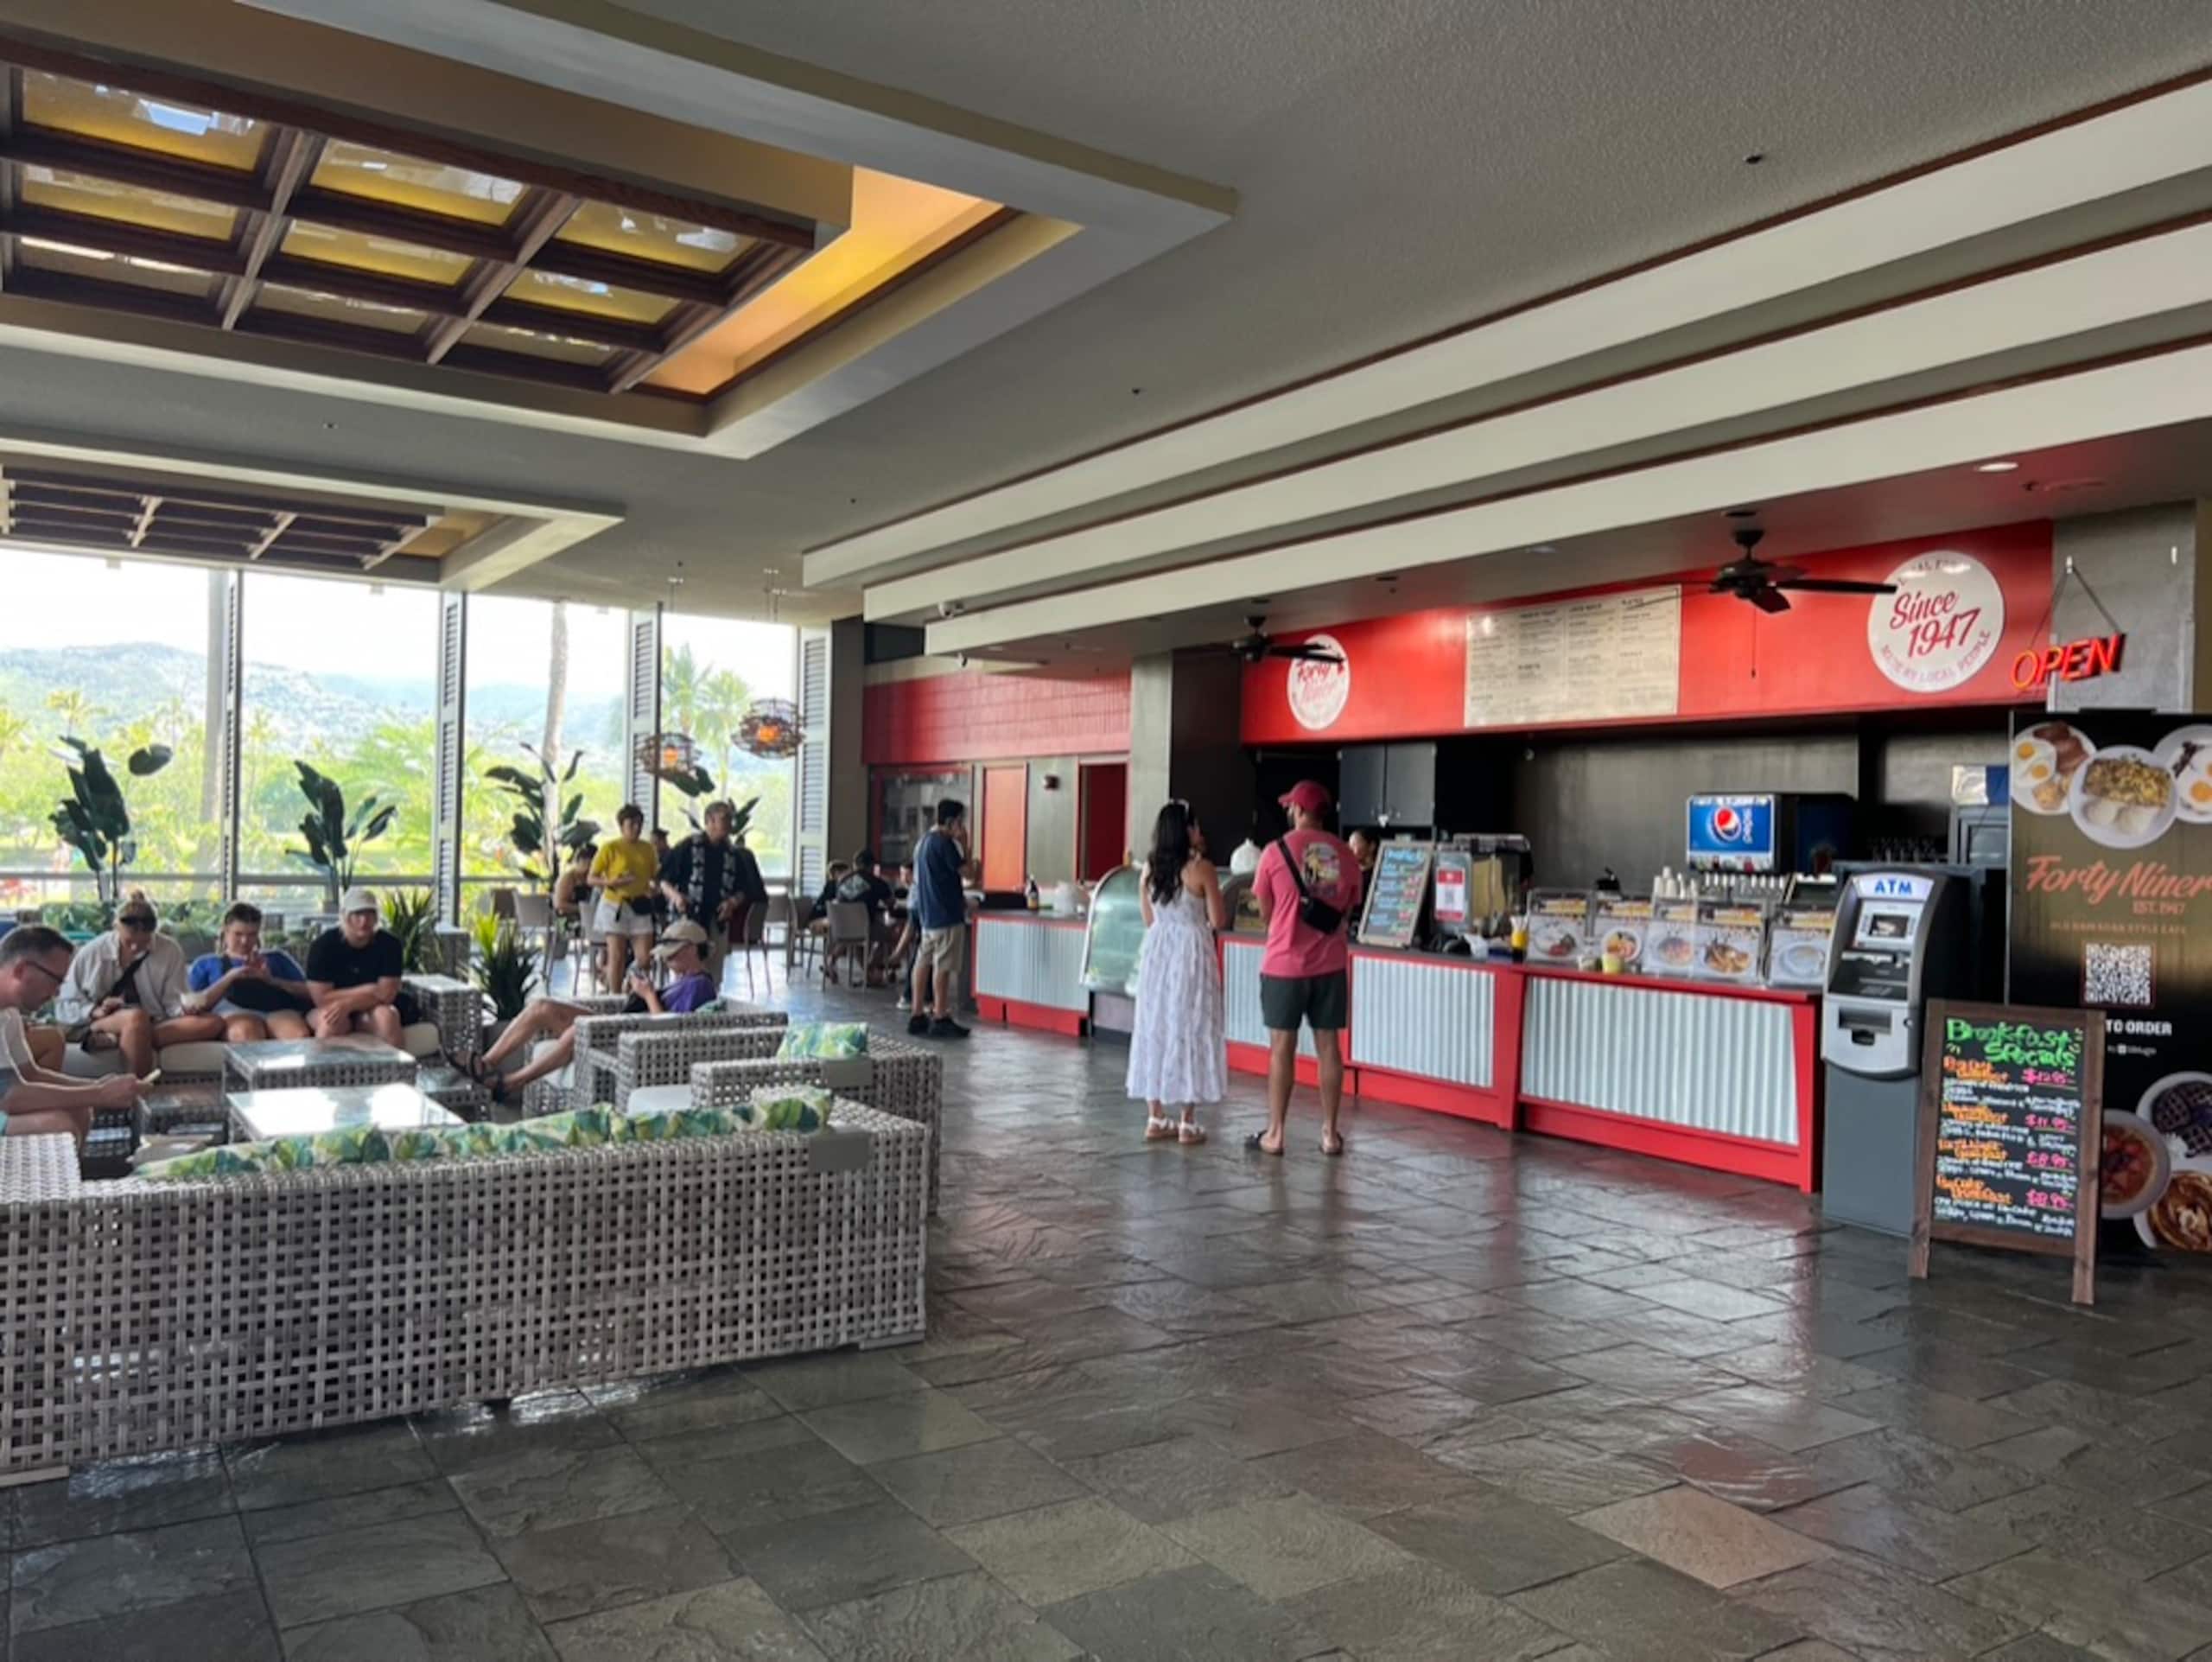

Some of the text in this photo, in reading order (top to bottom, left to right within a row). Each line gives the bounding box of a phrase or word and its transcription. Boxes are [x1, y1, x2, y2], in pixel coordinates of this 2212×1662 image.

[1889, 590, 1957, 630] Since
[1908, 607, 1981, 658] 1947
[2011, 633, 2122, 690] OPEN
[1874, 878, 1913, 895] ATM
[2025, 855, 2120, 905] Forty
[2106, 1019, 2172, 1036] TO ORDER
